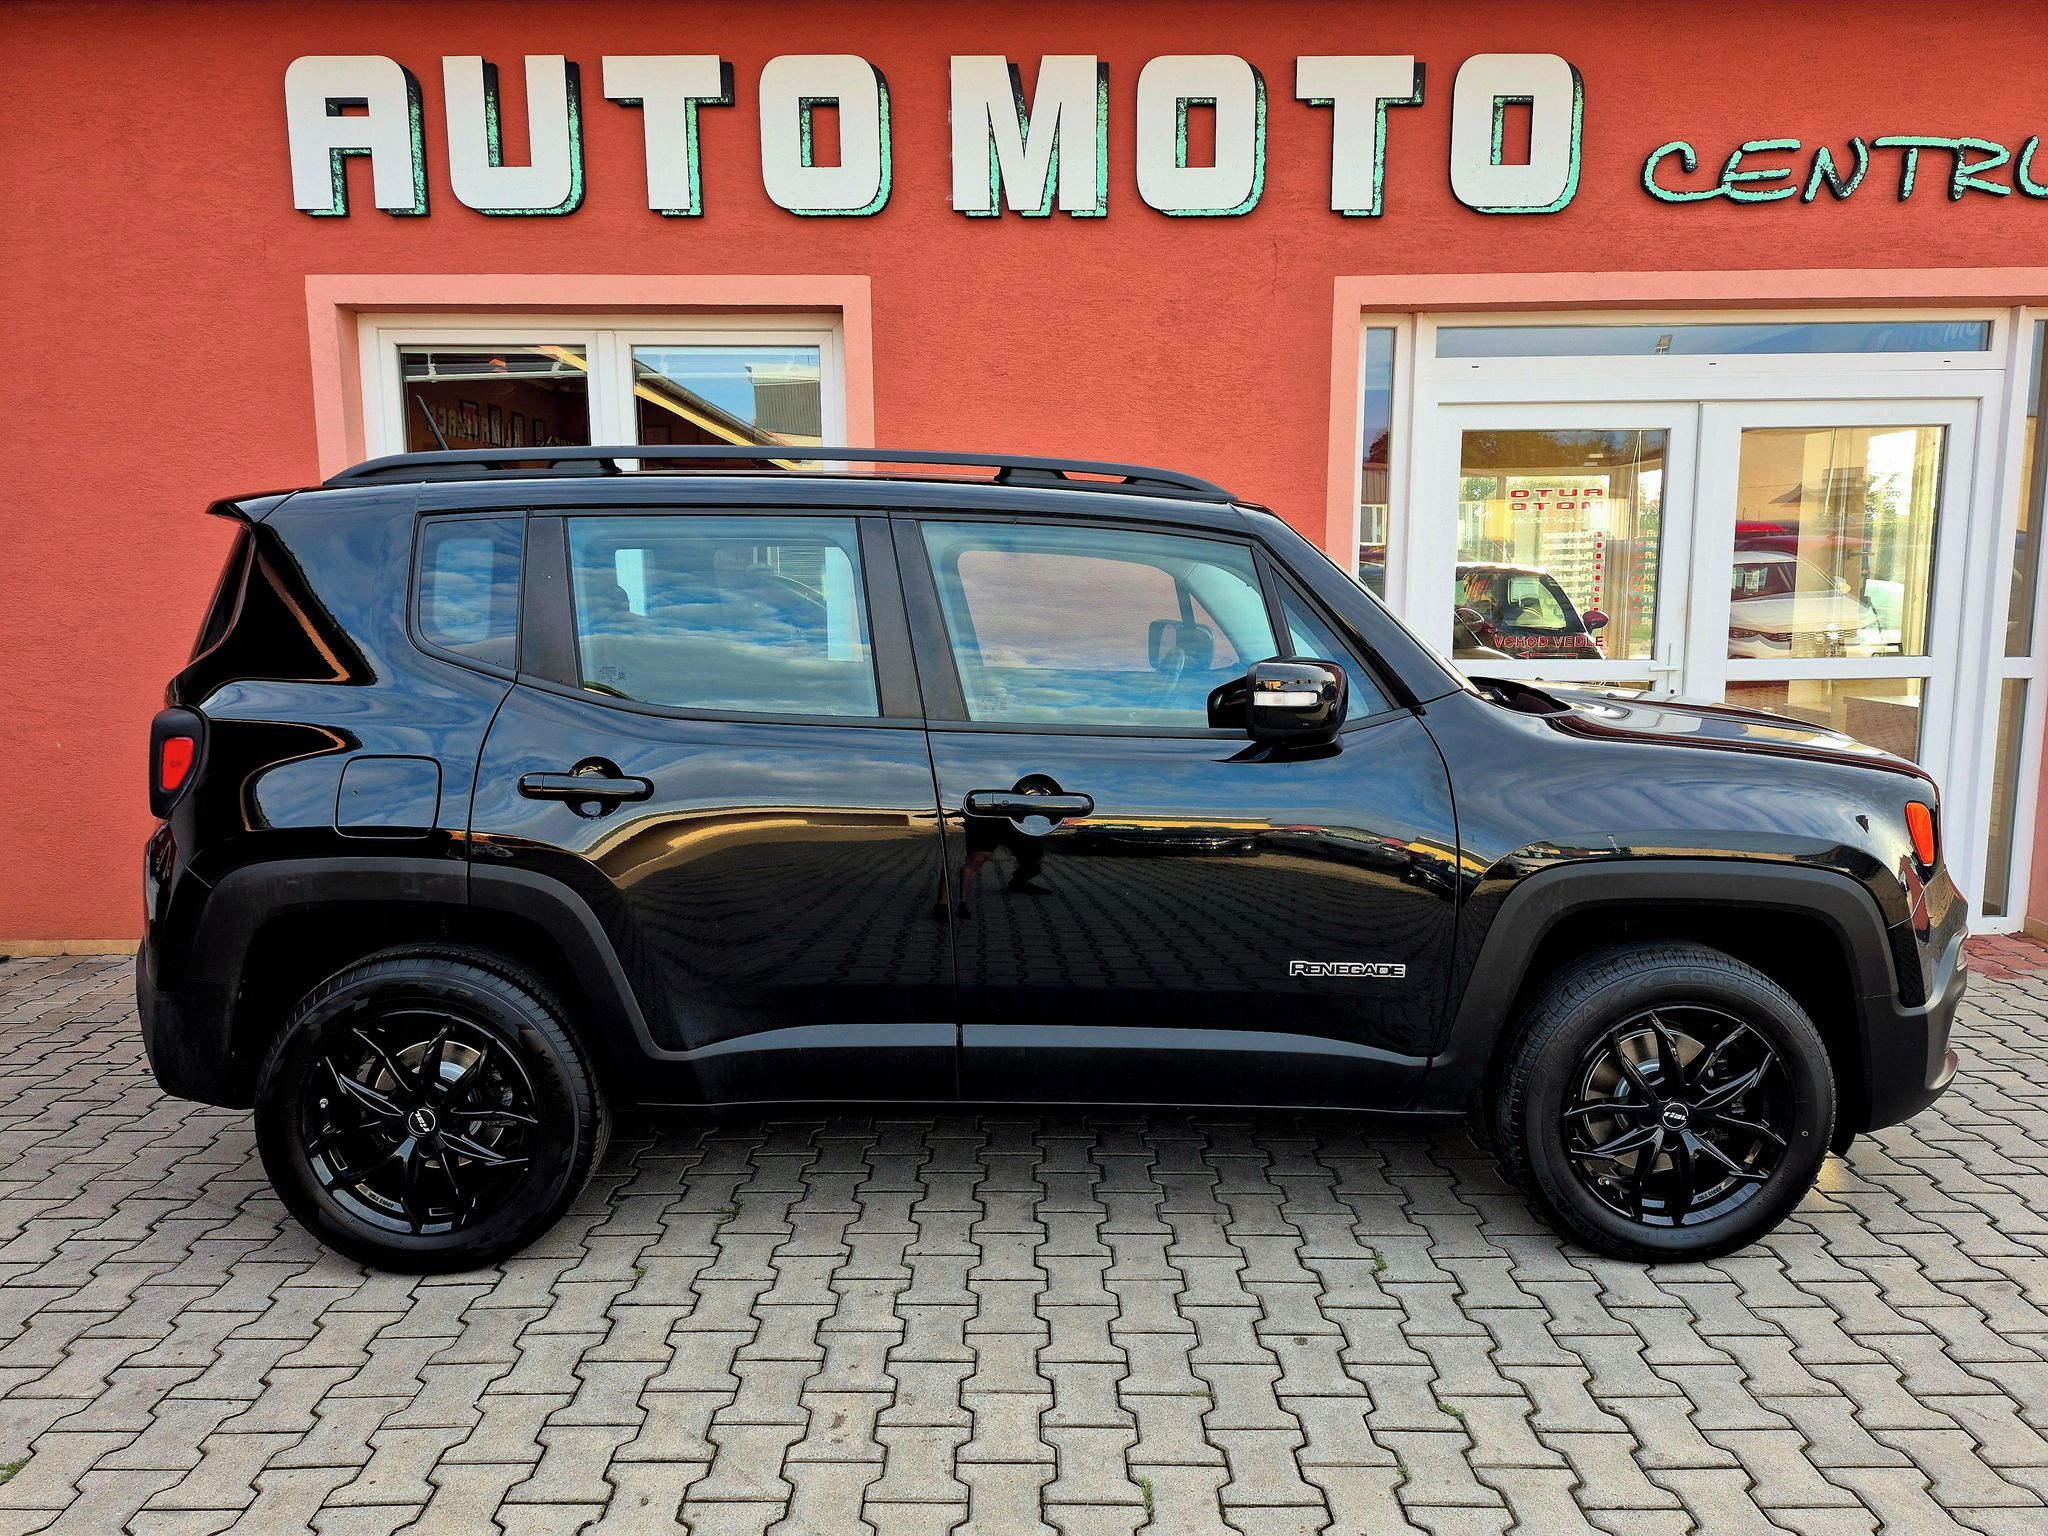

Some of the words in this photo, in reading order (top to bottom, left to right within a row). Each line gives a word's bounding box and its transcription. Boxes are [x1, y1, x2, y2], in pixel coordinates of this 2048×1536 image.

[284, 54, 893, 217] AUTO
[948, 53, 1585, 218] MOTO
[1493, 635, 1549, 648] VCHOD
[1552, 635, 1604, 648] VEDLE
[1289, 960, 1406, 978] RENEGADE
